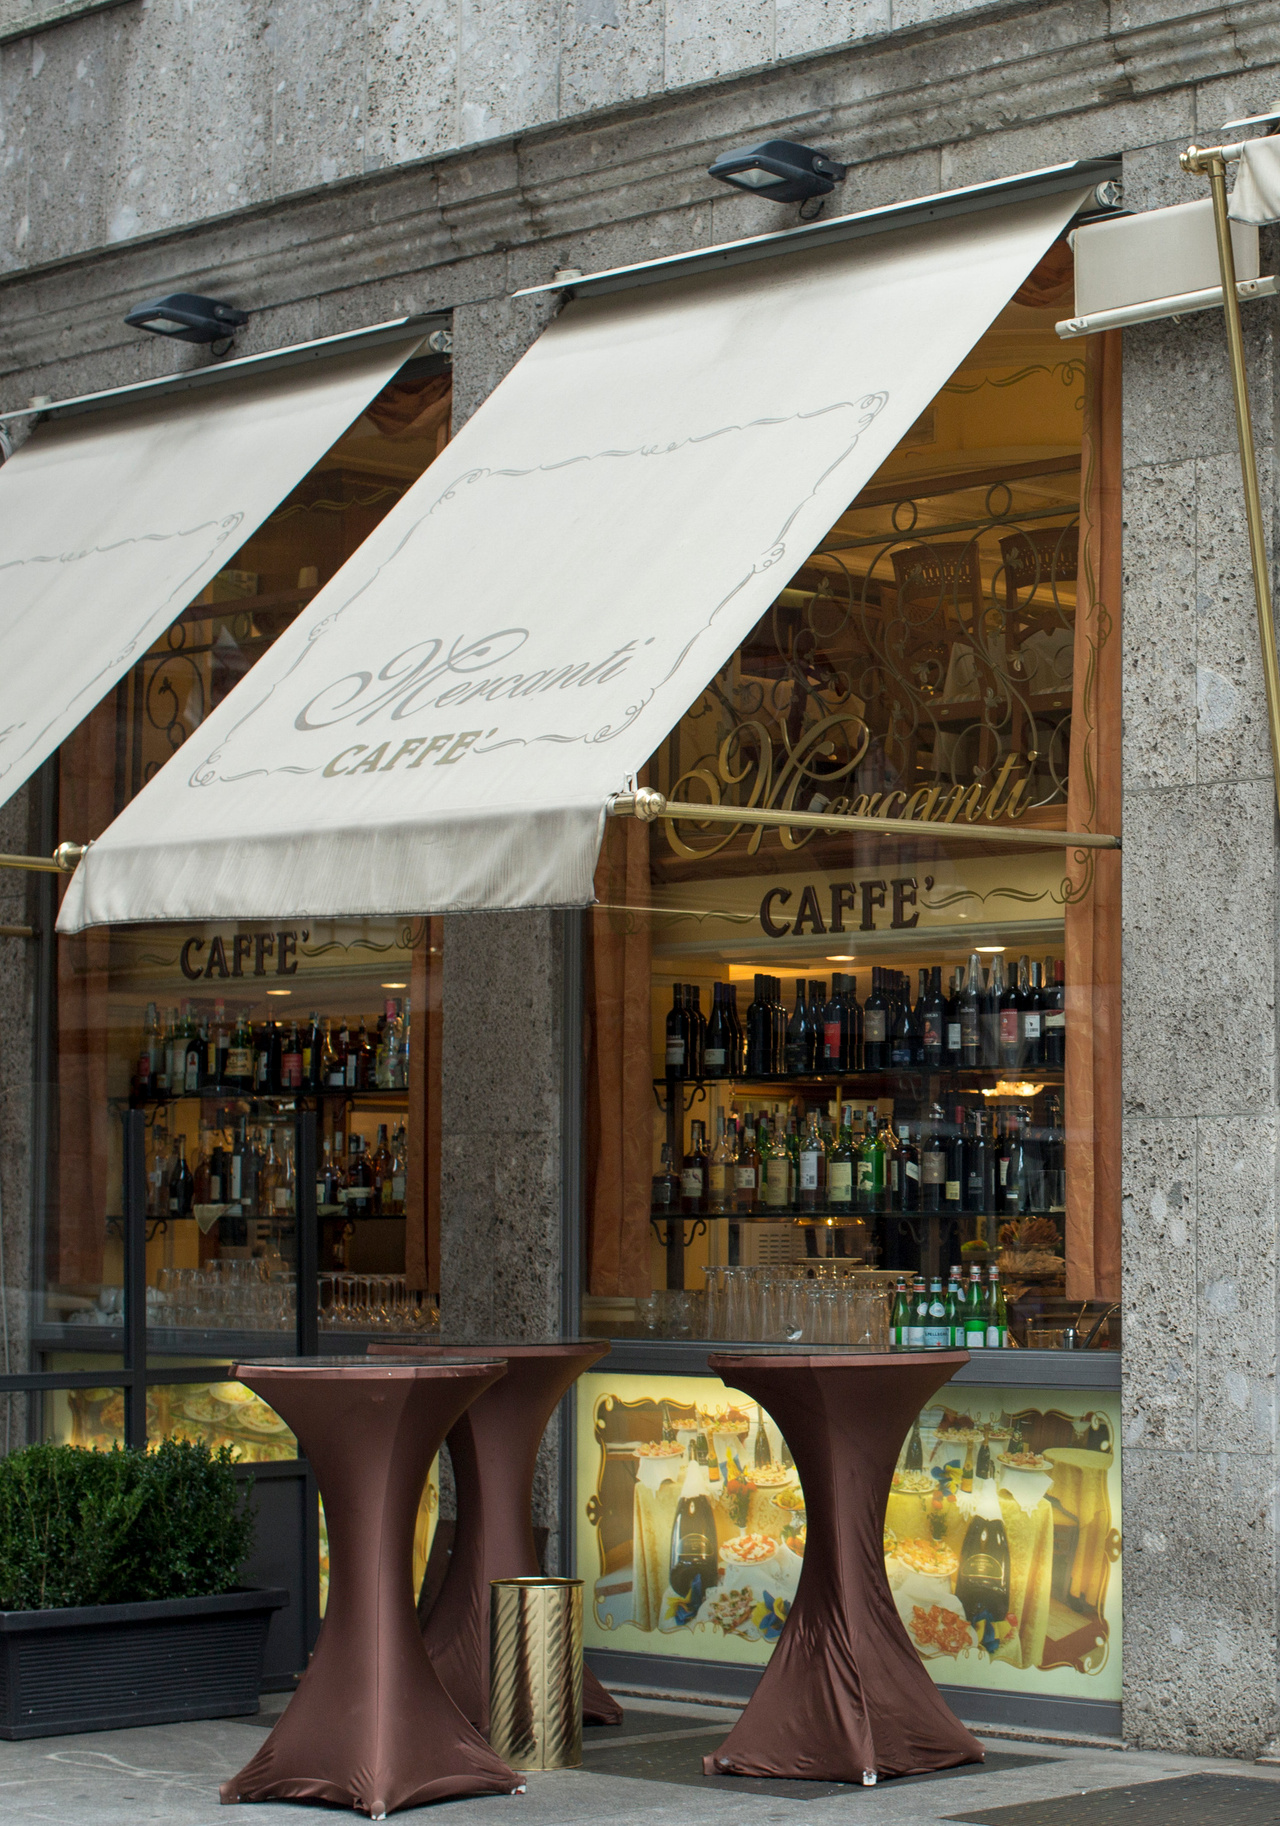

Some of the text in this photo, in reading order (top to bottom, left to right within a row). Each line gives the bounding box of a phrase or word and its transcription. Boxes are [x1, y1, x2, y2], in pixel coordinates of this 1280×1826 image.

[294, 627, 656, 731] Mercanti
[322, 727, 499, 778] CAFFE'
[759, 875, 935, 938] CAFFE'
[180, 929, 309, 980] CAFFE'
